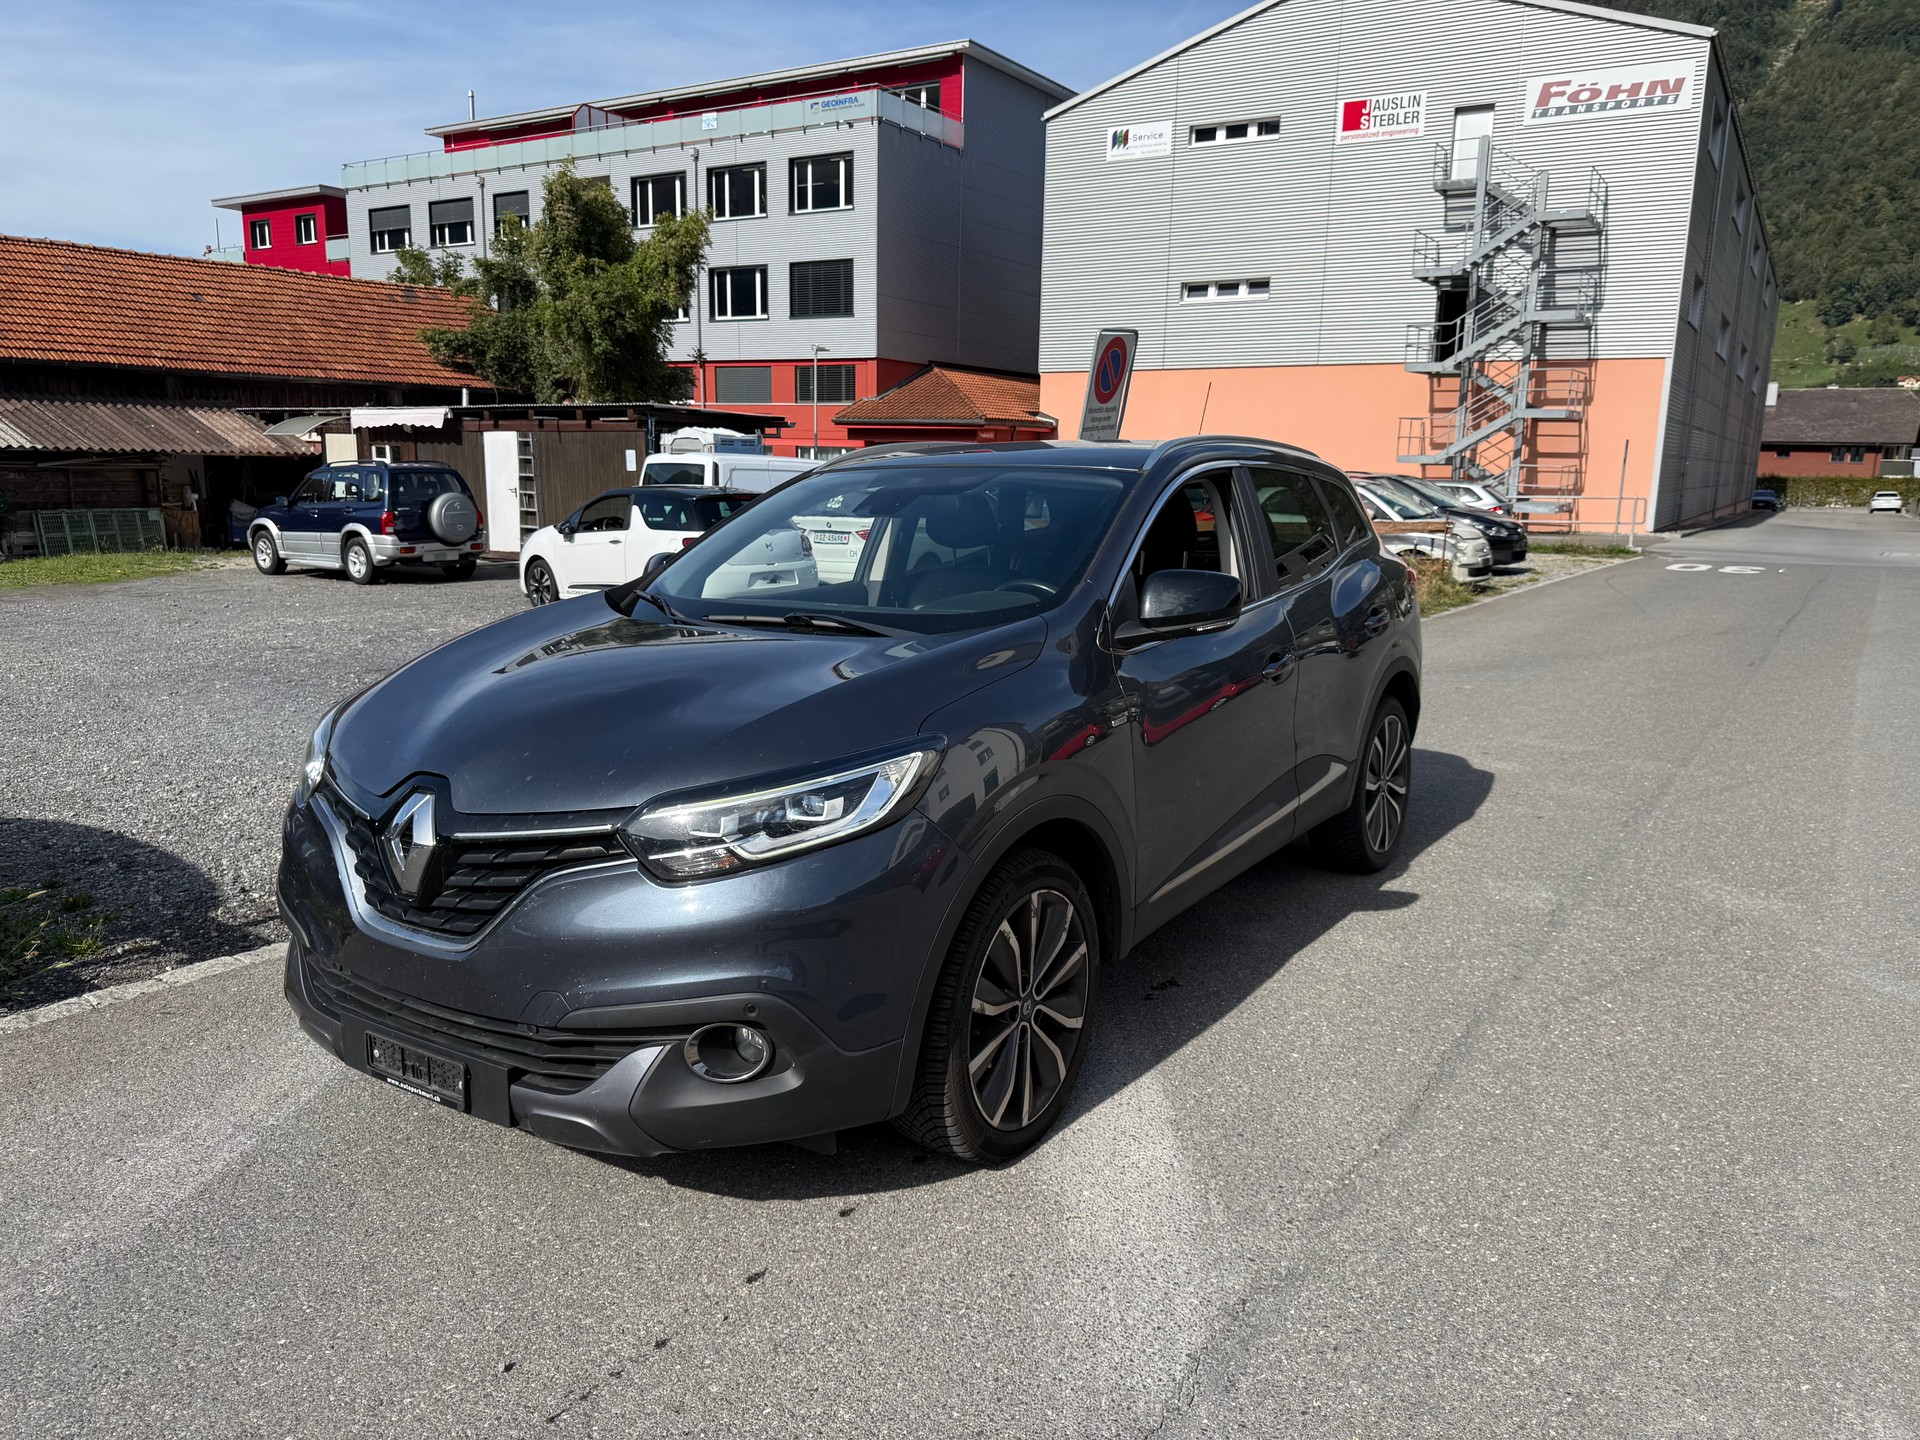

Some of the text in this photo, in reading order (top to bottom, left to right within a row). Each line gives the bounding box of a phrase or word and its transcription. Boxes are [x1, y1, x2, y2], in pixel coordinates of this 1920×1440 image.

[820, 96, 859, 108] GEOINFRA
[1534, 95, 1678, 118] TRANSPORTE
[1341, 127, 1419, 142] personalized engineering
[850, 550, 858, 558] CH
